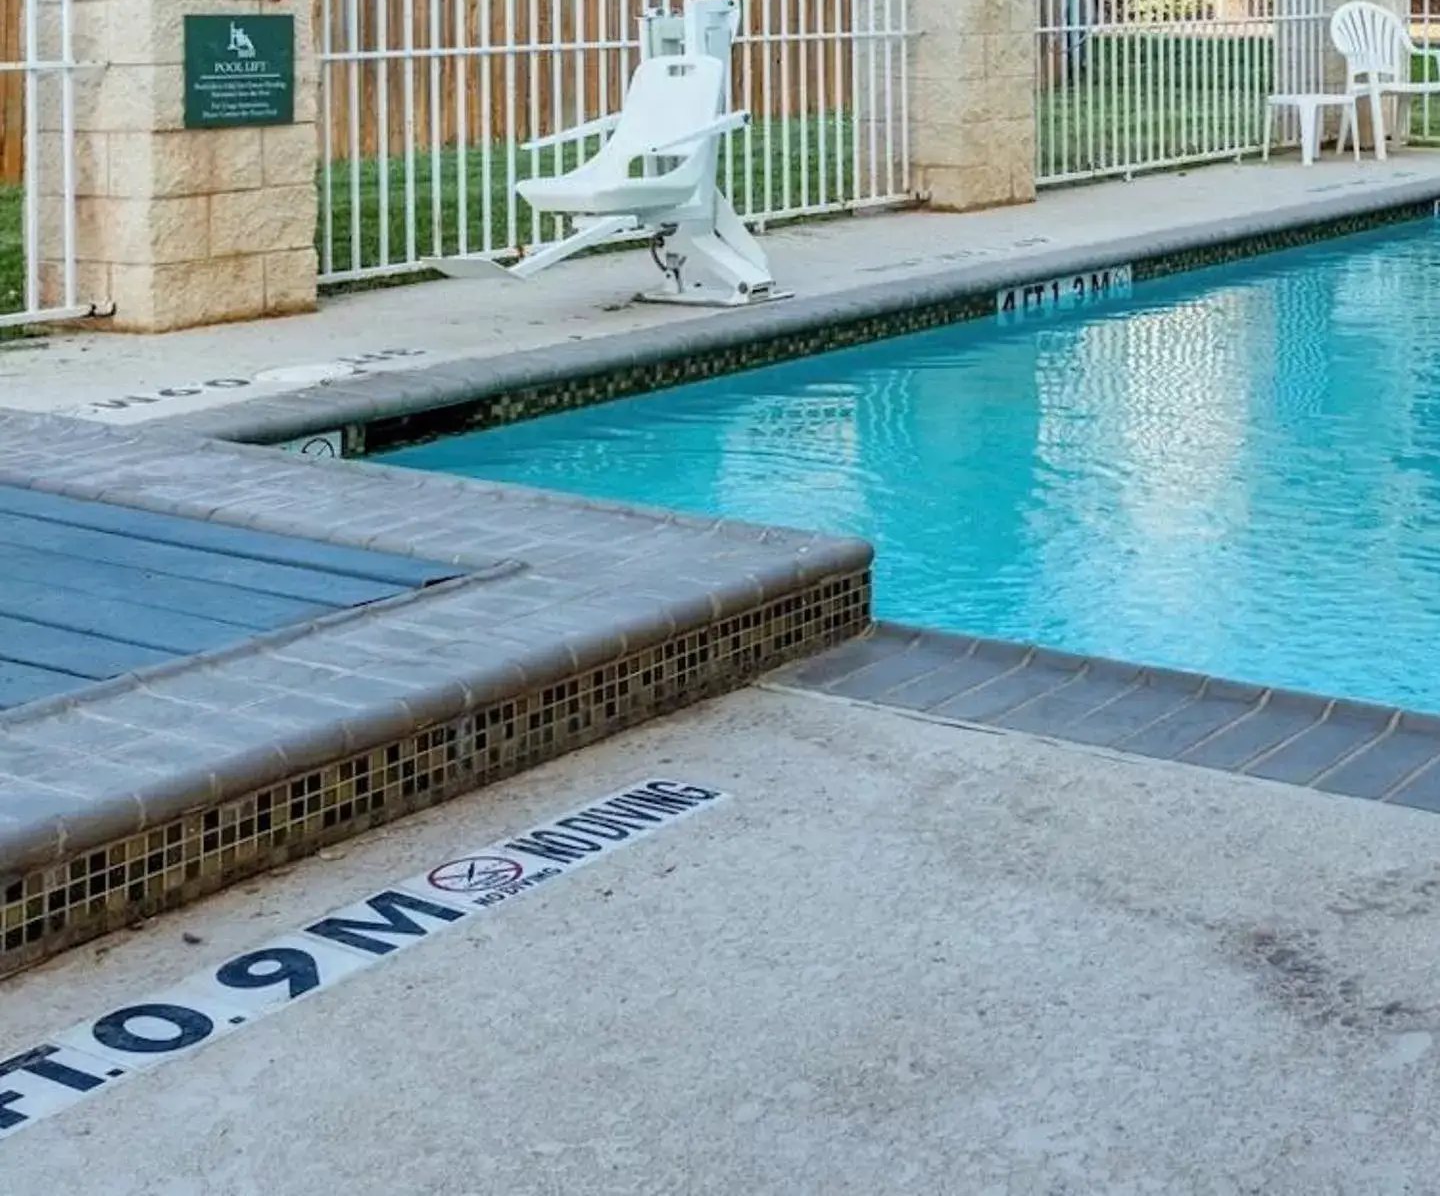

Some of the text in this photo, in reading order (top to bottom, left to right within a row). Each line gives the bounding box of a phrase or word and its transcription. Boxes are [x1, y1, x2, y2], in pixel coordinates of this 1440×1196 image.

[214, 61, 268, 73] POOL LIFT
[504, 780, 721, 864] NO DIVING
